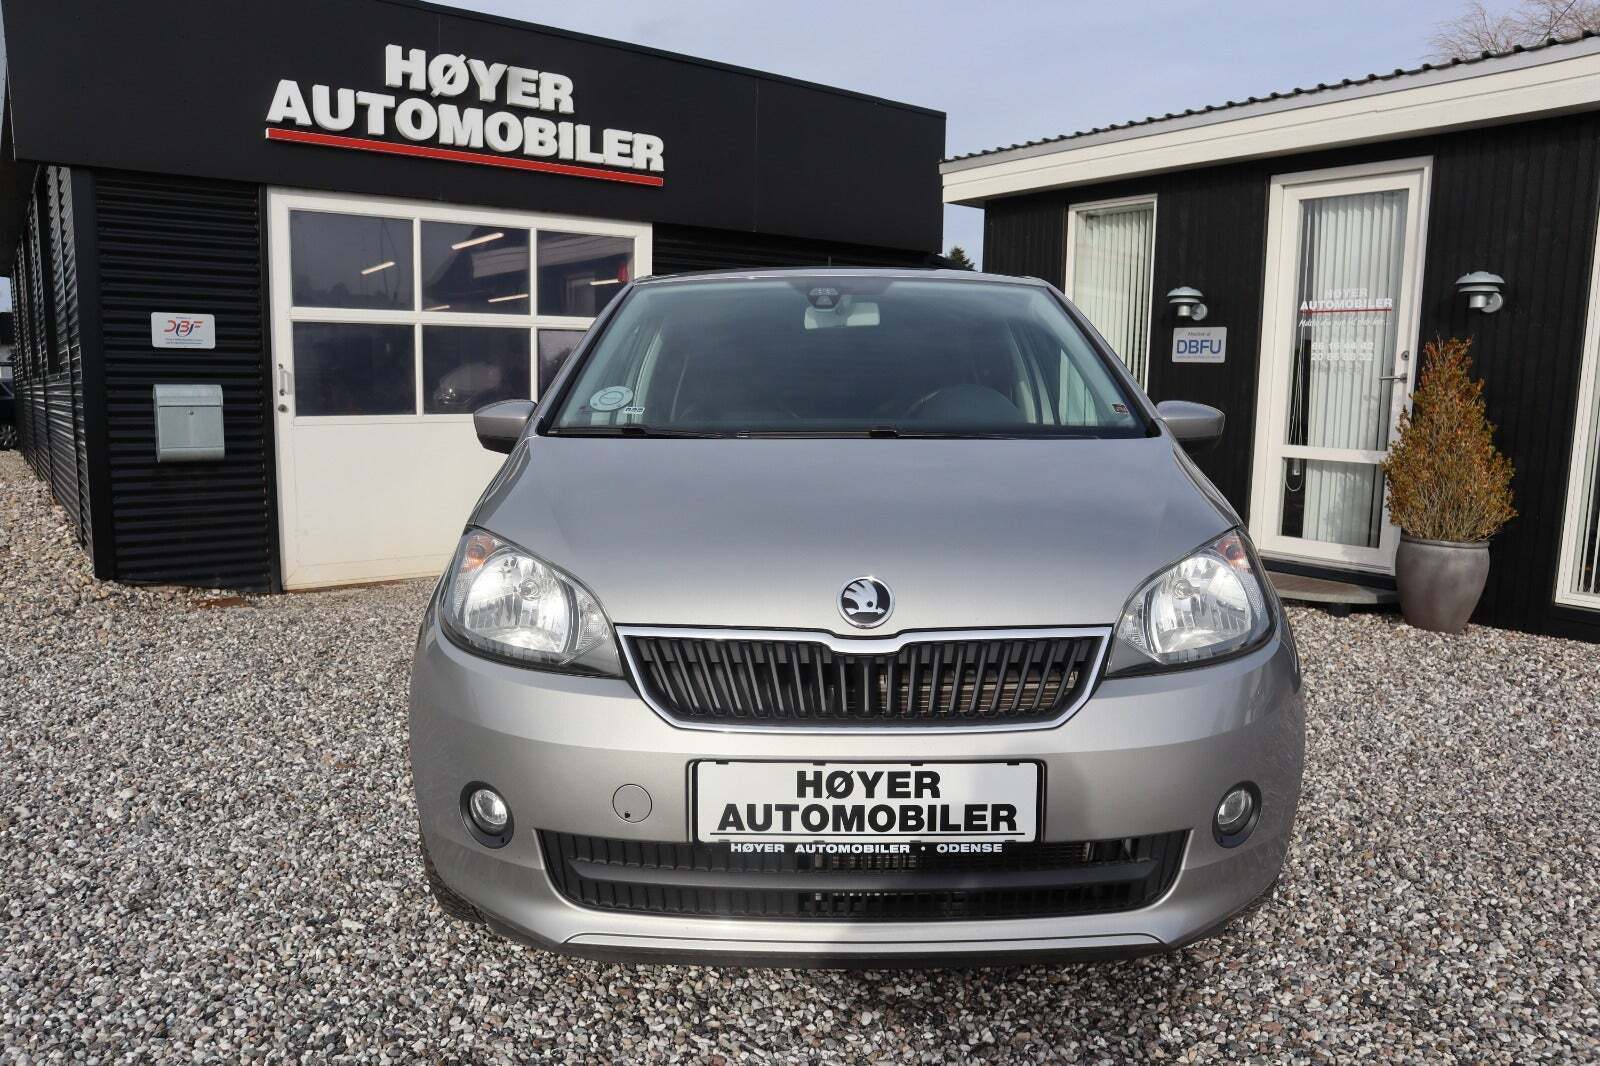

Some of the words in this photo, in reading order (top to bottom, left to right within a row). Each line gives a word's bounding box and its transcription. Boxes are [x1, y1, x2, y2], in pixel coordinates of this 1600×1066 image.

[385, 44, 575, 114] HØYER
[266, 79, 665, 171] AUTOMOBILER
[1300, 298, 1393, 310] AUTOMOBILER
[1176, 339, 1222, 354] DBFU
[796, 769, 942, 800] HØYER
[716, 803, 1019, 833] AUTOMOBILER
[730, 843, 785, 853] HØYER
[795, 843, 911, 854] AUTOMOBILER
[936, 843, 1003, 853] ODENSE
